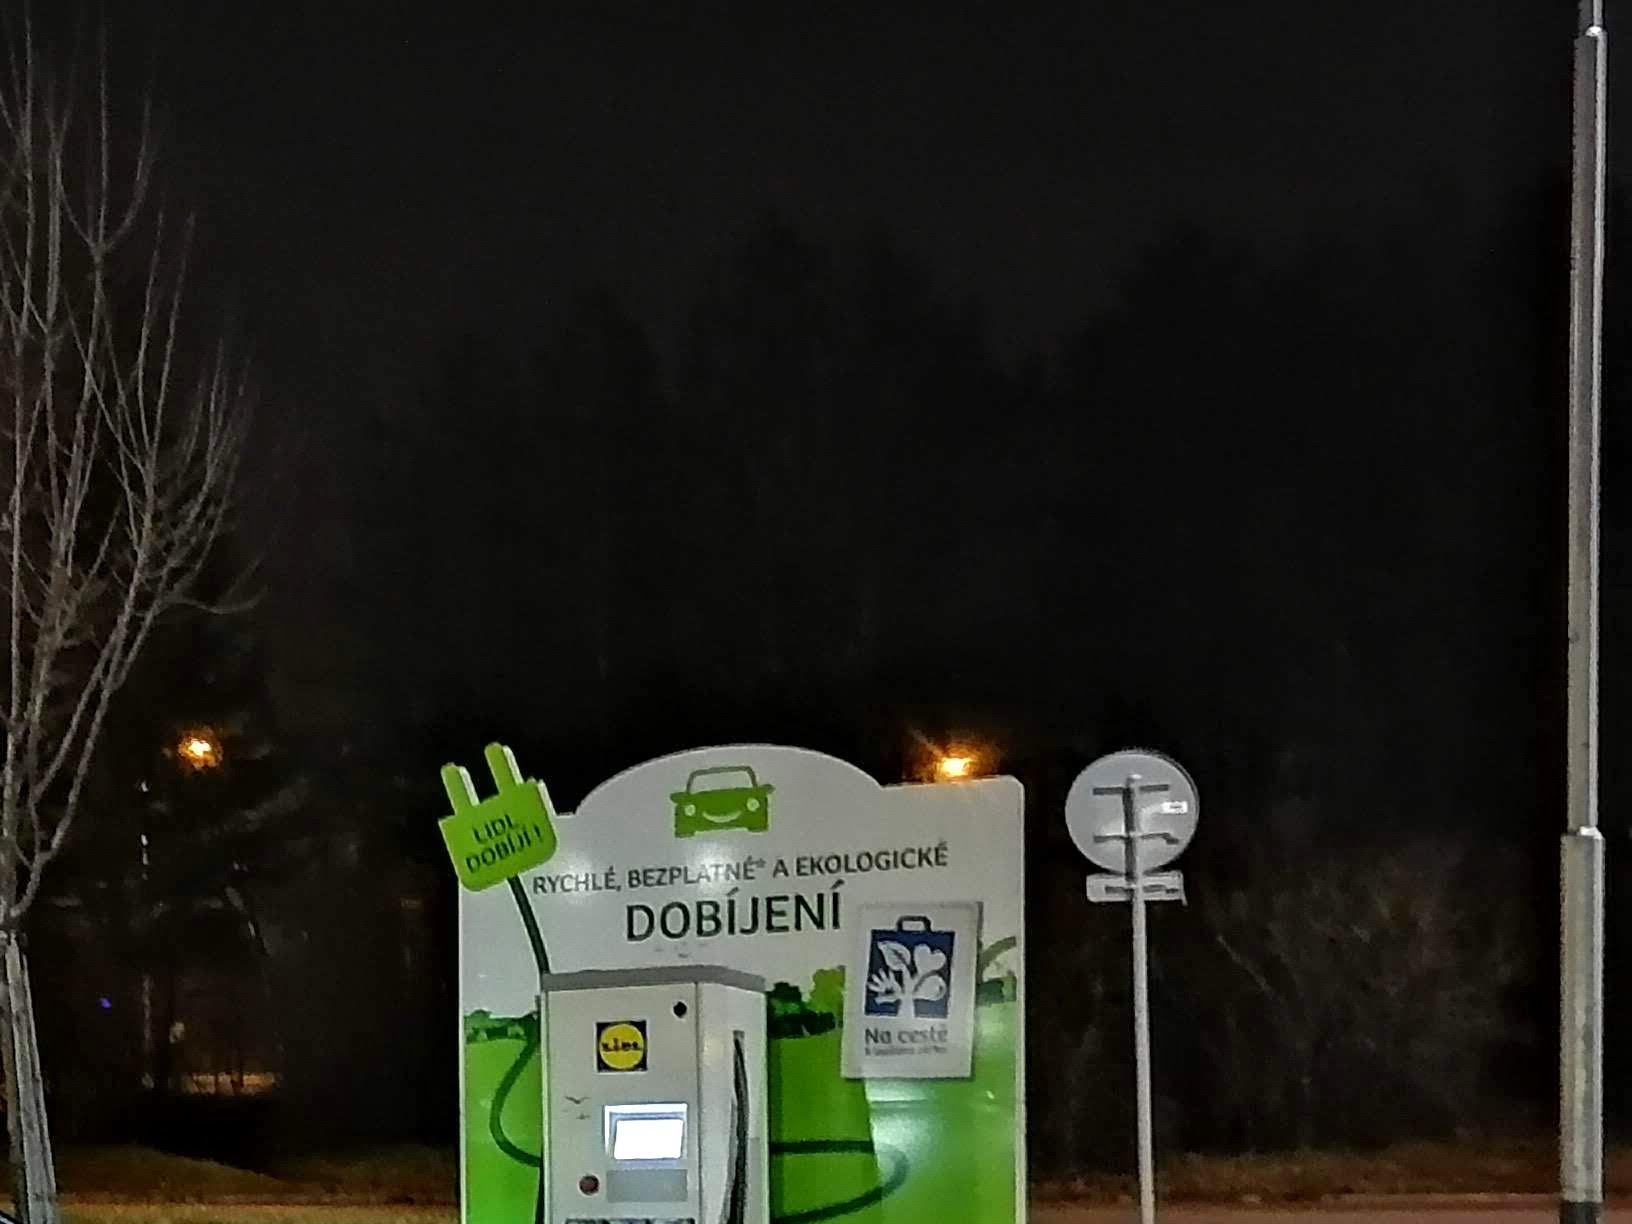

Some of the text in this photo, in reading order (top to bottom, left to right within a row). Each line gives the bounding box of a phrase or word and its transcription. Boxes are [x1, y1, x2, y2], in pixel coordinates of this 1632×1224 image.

[472, 814, 519, 844] LIDL
[533, 866, 621, 894] RYCHLÉ,
[773, 859, 789, 878] A
[795, 841, 948, 877] EKOLOGICKÉ
[626, 879, 844, 942] DOBÍJENÍ
